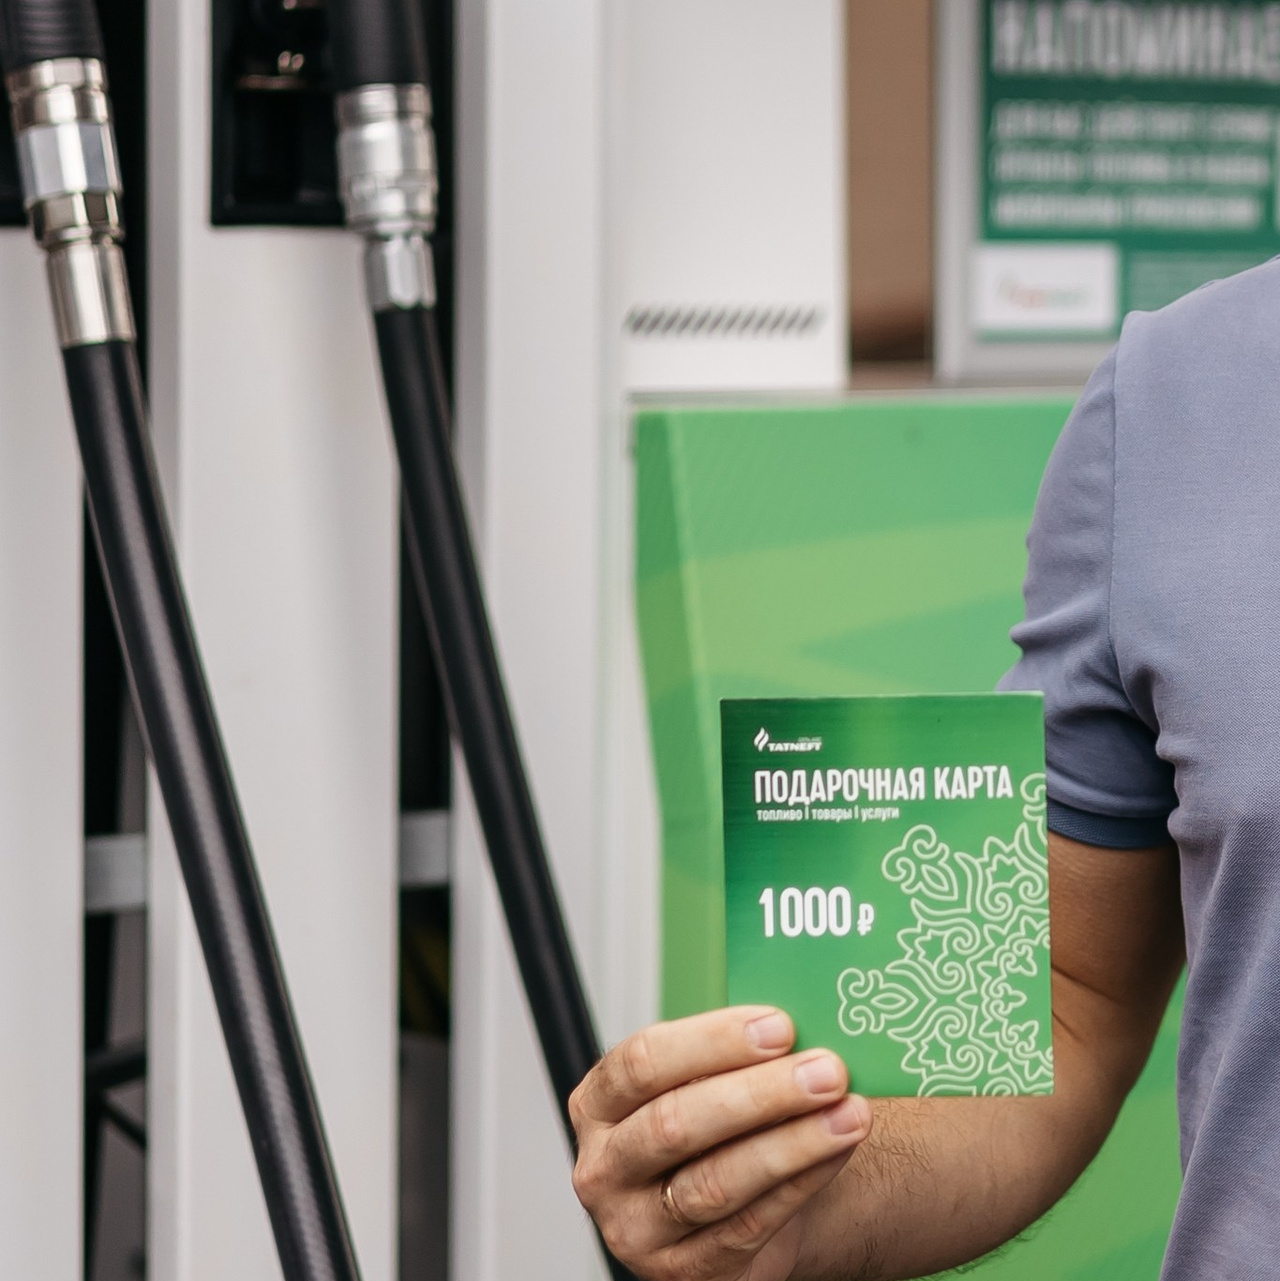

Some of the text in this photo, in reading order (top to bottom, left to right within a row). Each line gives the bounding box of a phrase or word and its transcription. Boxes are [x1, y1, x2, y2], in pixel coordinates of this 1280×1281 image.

[754, 765, 1013, 806] ПОДАРОЧНАЯ КАРТА
[756, 807, 899, 823] топливо товары услуги
